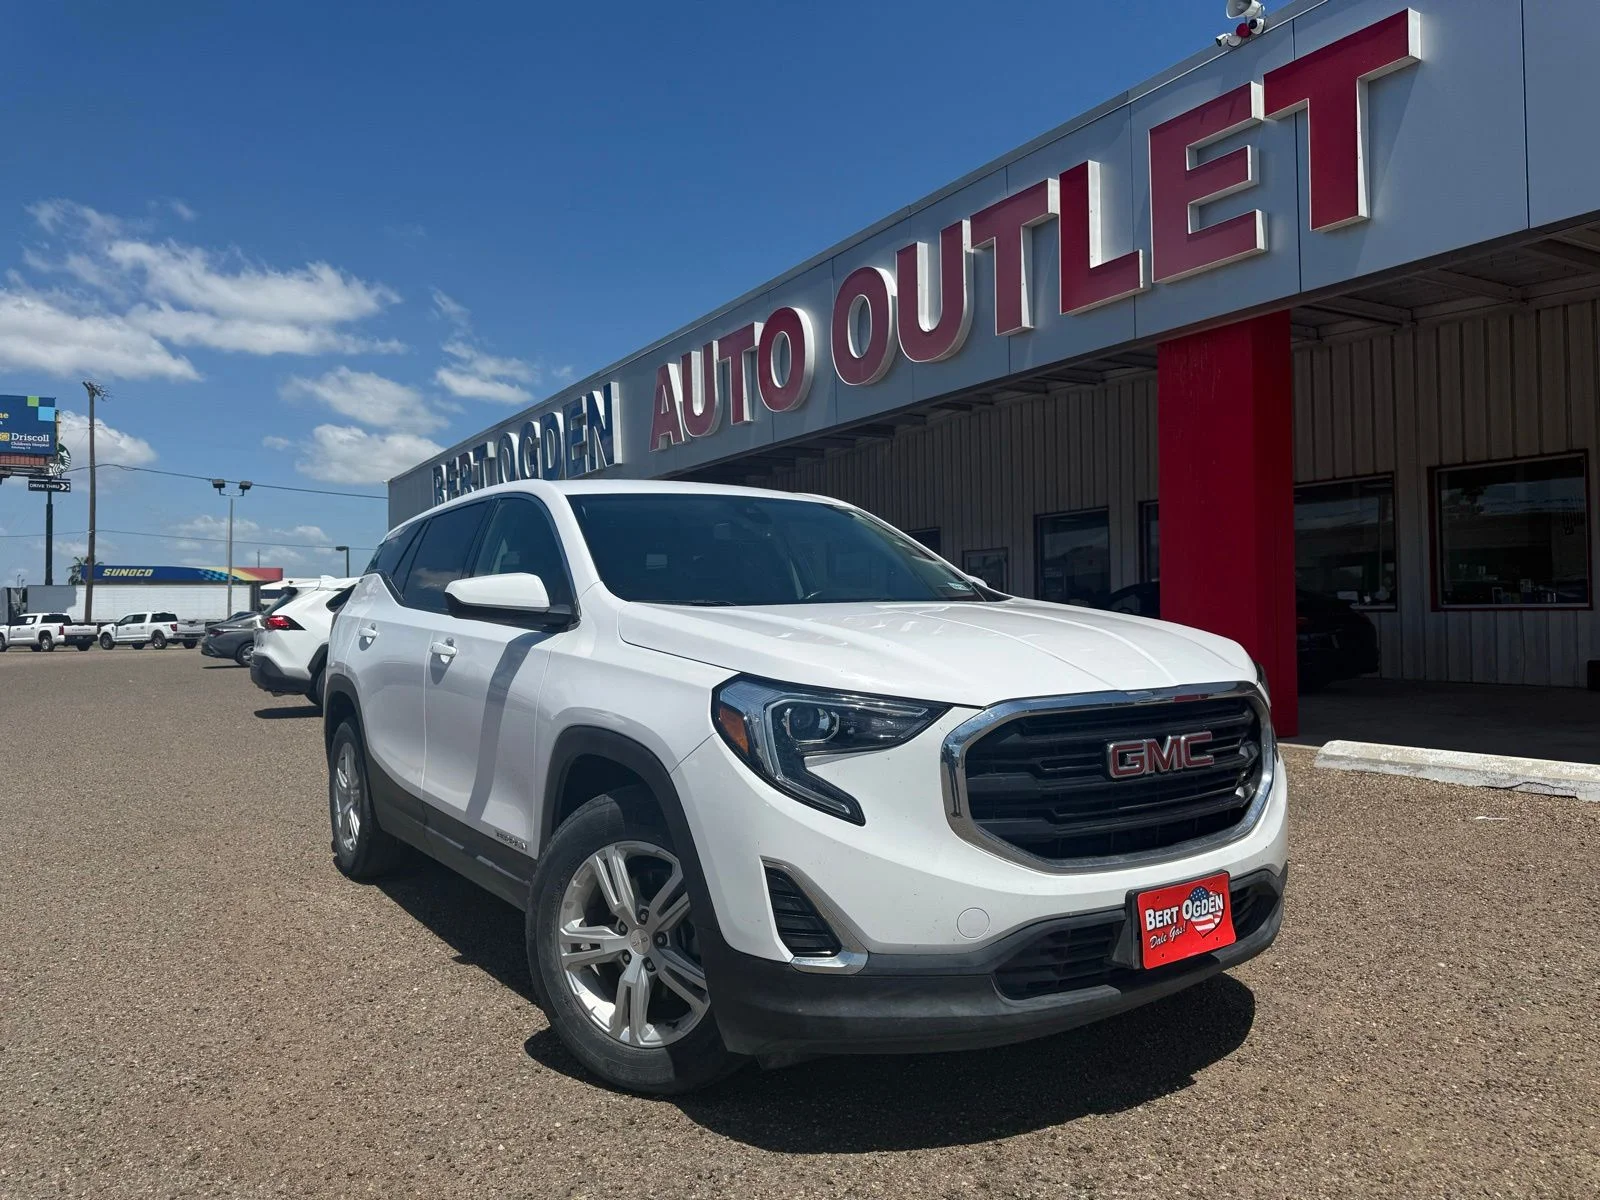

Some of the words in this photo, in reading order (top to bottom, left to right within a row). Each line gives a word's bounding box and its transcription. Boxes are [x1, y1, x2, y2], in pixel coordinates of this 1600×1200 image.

[432, 441, 496, 507] BERT
[498, 382, 624, 484] OGDEN
[649, 306, 815, 452] AUTO
[831, 8, 1422, 386] OUTLET
[11, 432, 49, 442] Driscoll
[102, 568, 154, 577] SUNOCO
[1107, 731, 1214, 779] GMC
[1150, 932, 1167, 949] Dale
